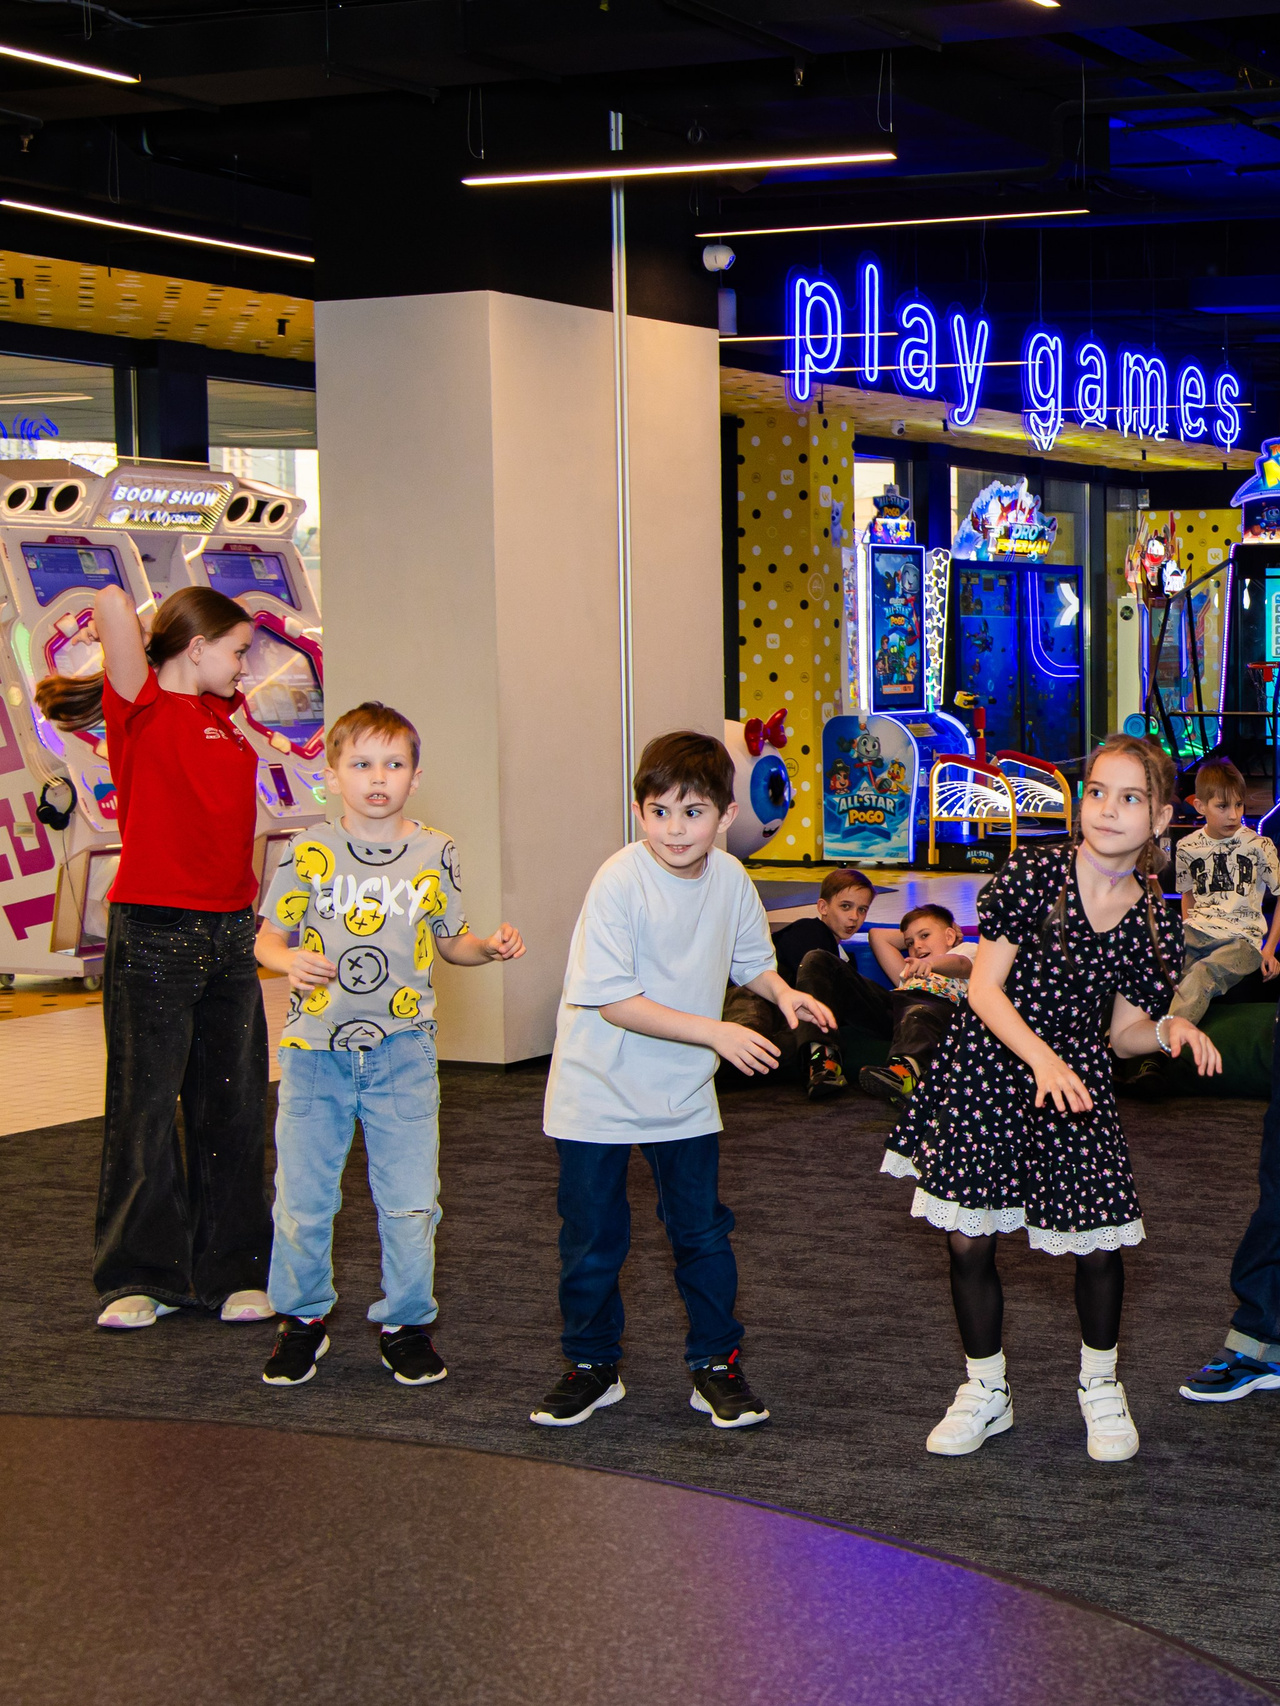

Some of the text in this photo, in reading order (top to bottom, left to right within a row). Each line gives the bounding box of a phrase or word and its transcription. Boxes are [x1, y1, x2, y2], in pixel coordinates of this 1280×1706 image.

[794, 262, 1240, 444] play games
[112, 485, 221, 507] BOOM SHOW
[1189, 853, 1253, 896] GAP
[312, 873, 431, 926] LUCKY
